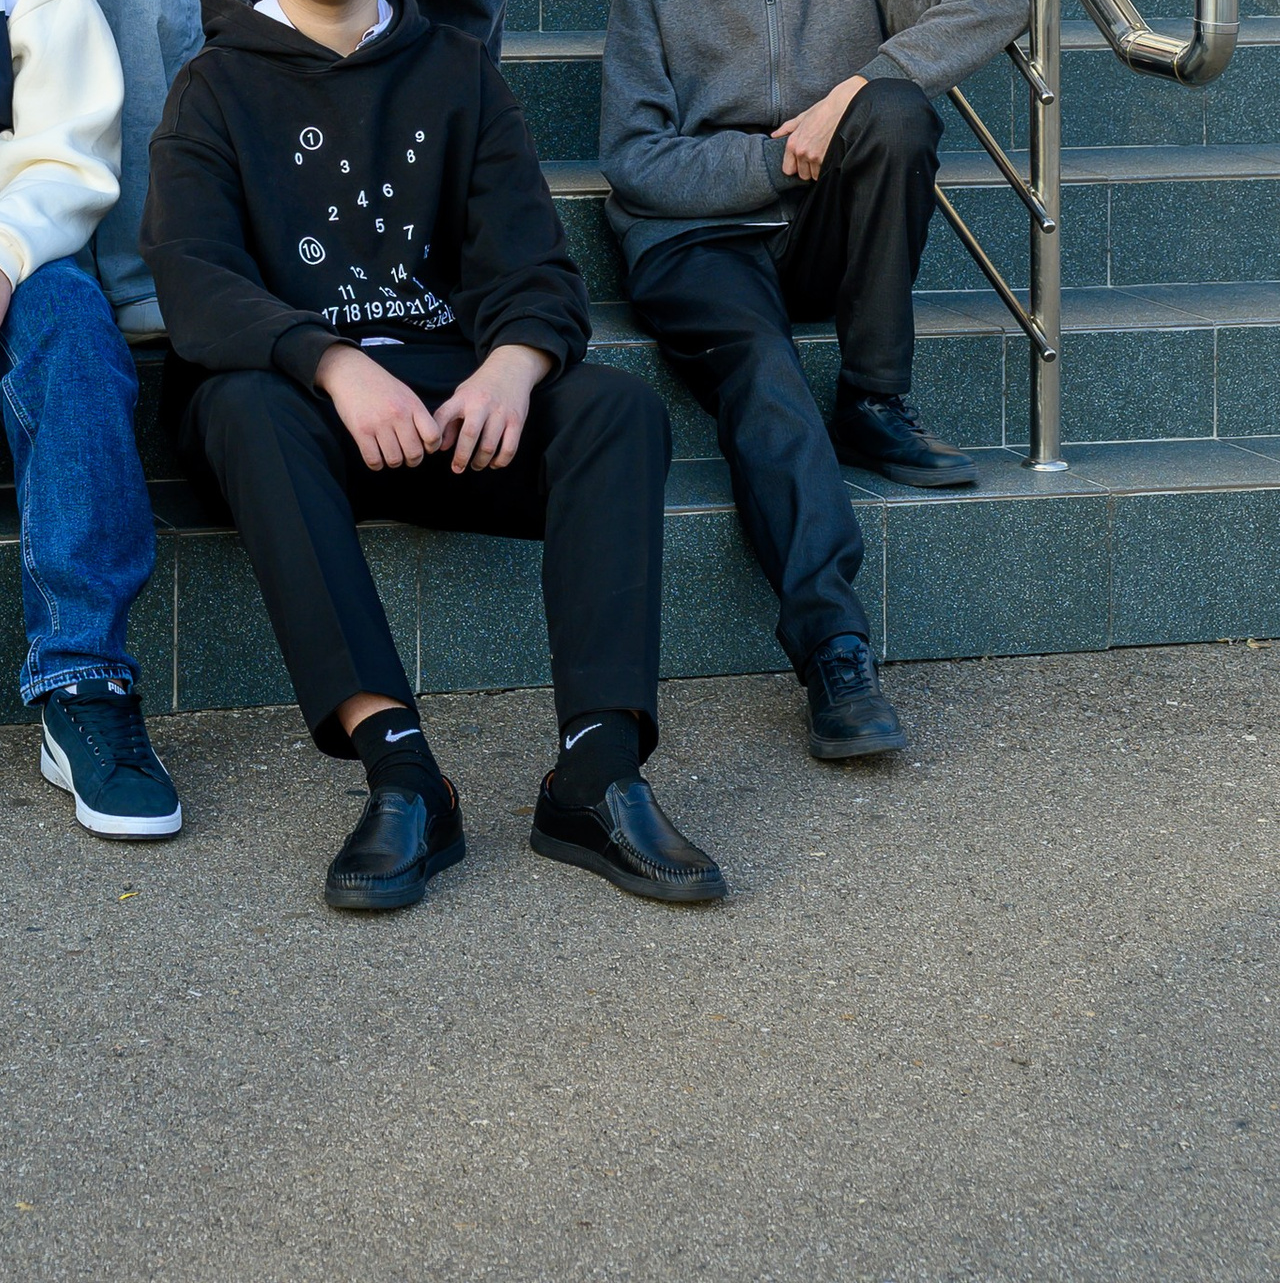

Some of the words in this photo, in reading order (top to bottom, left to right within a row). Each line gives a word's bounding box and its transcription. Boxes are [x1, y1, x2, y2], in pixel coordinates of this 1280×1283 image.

[414, 130, 425, 143] 9
[294, 152, 304, 165] 0
[406, 149, 416, 164] 8
[340, 159, 350, 174] 3
[382, 183, 394, 198] 6
[357, 190, 369, 208] 4
[328, 206, 339, 222] 2
[375, 218, 385, 233] 5
[403, 224, 415, 241] 7
[350, 265, 368, 281] 12
[390, 263, 408, 284] 14
[338, 284, 357, 301] 11
[379, 286, 397, 298] 13
[322, 307, 339, 326] 17
[343, 303, 361, 323] 18
[364, 301, 383, 320] 19
[386, 300, 405, 317] 20
[406, 298, 425, 315] 21
